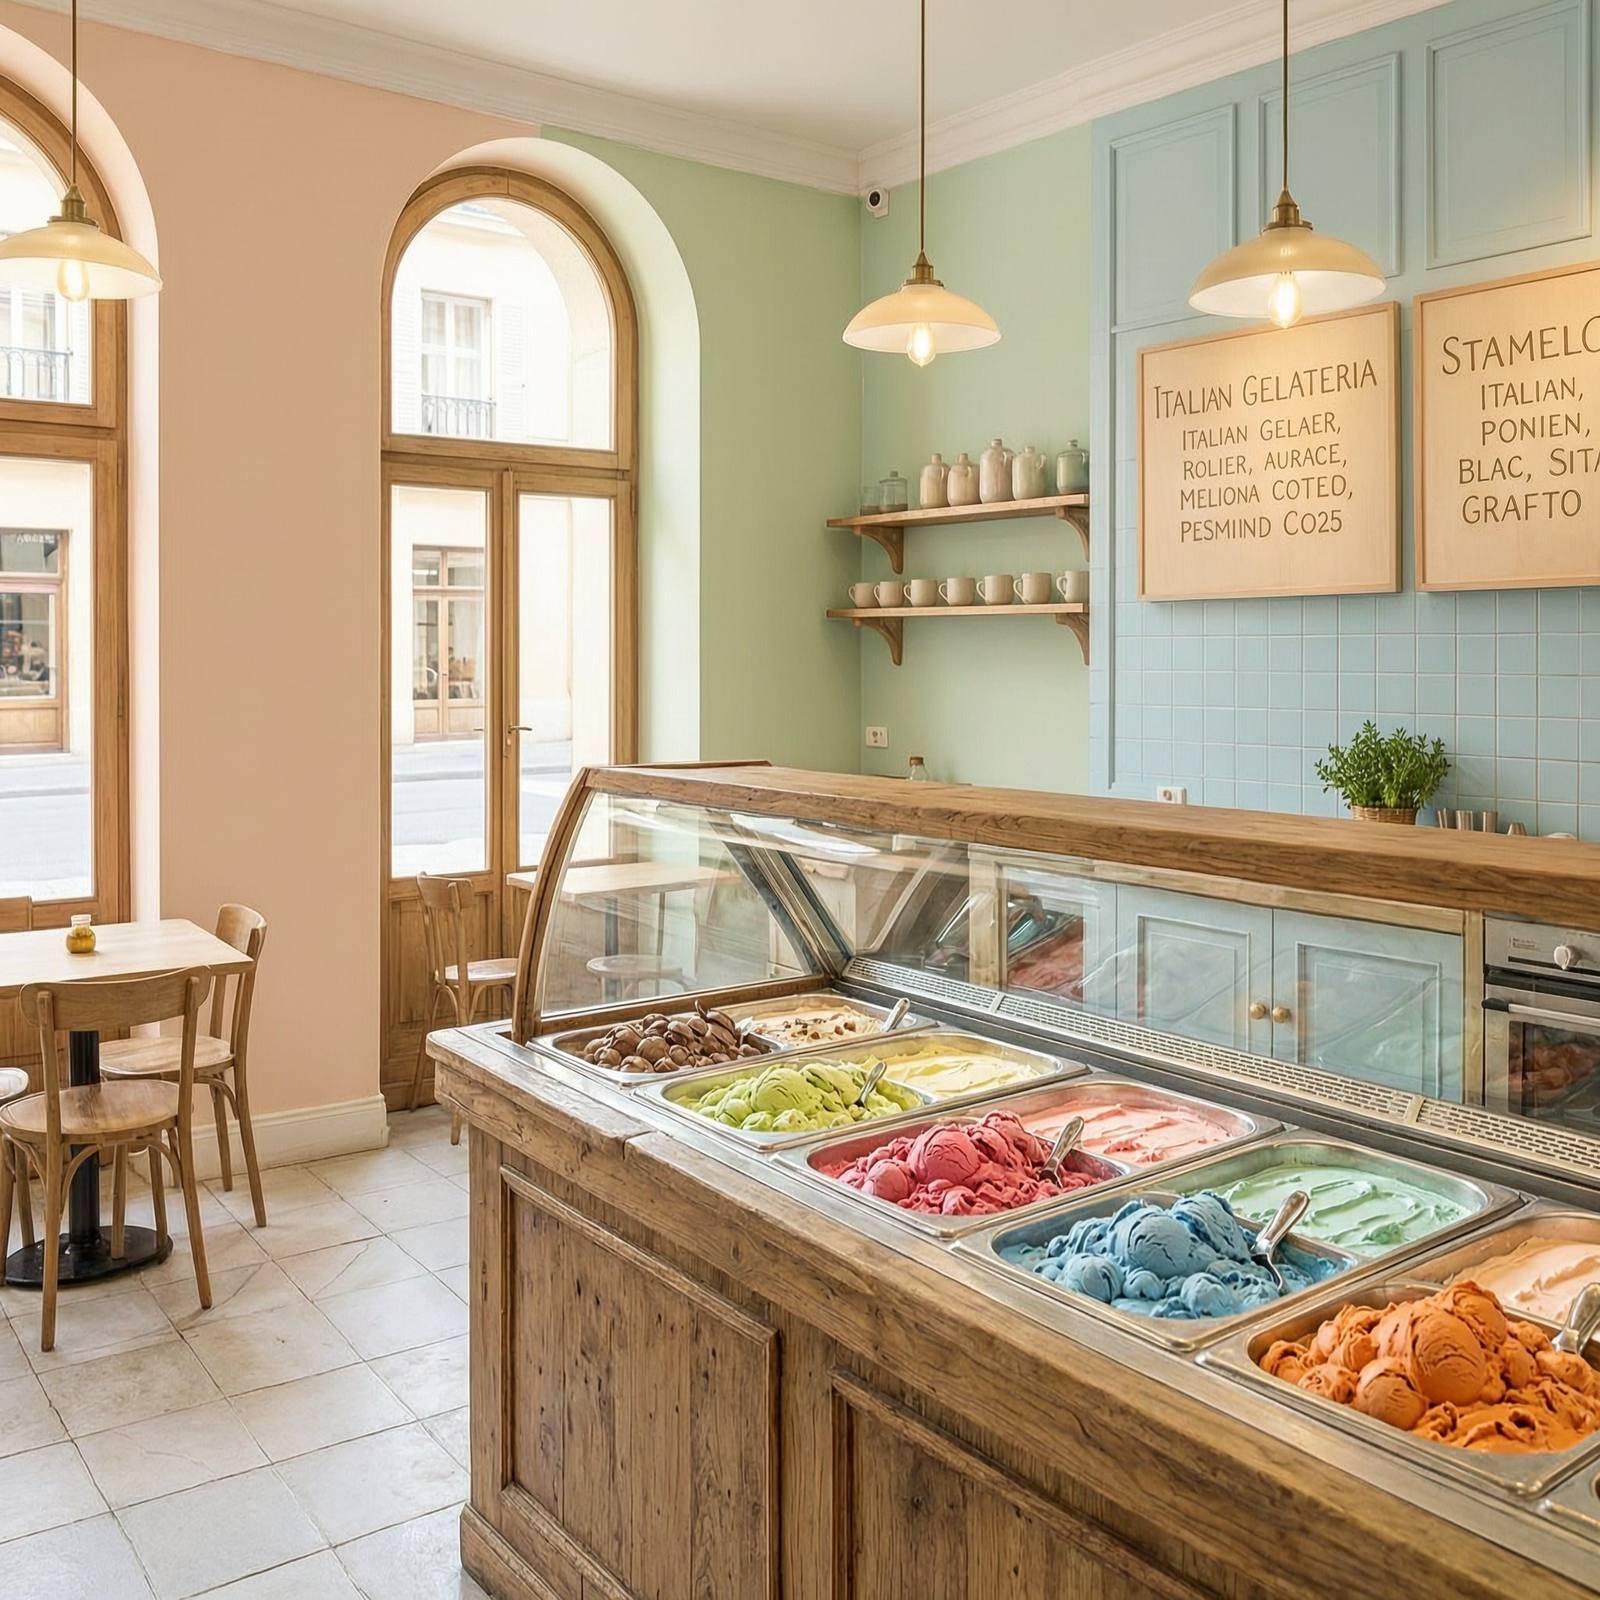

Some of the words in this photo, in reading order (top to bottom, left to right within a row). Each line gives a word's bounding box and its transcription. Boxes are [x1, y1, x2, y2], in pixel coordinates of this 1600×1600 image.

[1154, 383, 1232, 419] ITALIAN
[1242, 359, 1378, 406] GELATERIA
[1481, 376, 1584, 411] ITALIAN,
[1182, 425, 1248, 451] ITALIAN
[1259, 411, 1342, 441] GELAER,
[1481, 412, 1591, 446] PONIEN,
[1183, 455, 1253, 481] ROLIER,
[1264, 442, 1348, 471] AURACE,
[1459, 455, 1532, 485] BLAC,
[1180, 484, 1261, 511] MELIONA
[1272, 474, 1353, 501] COTED,
[1462, 489, 1582, 524] GRAFTO
